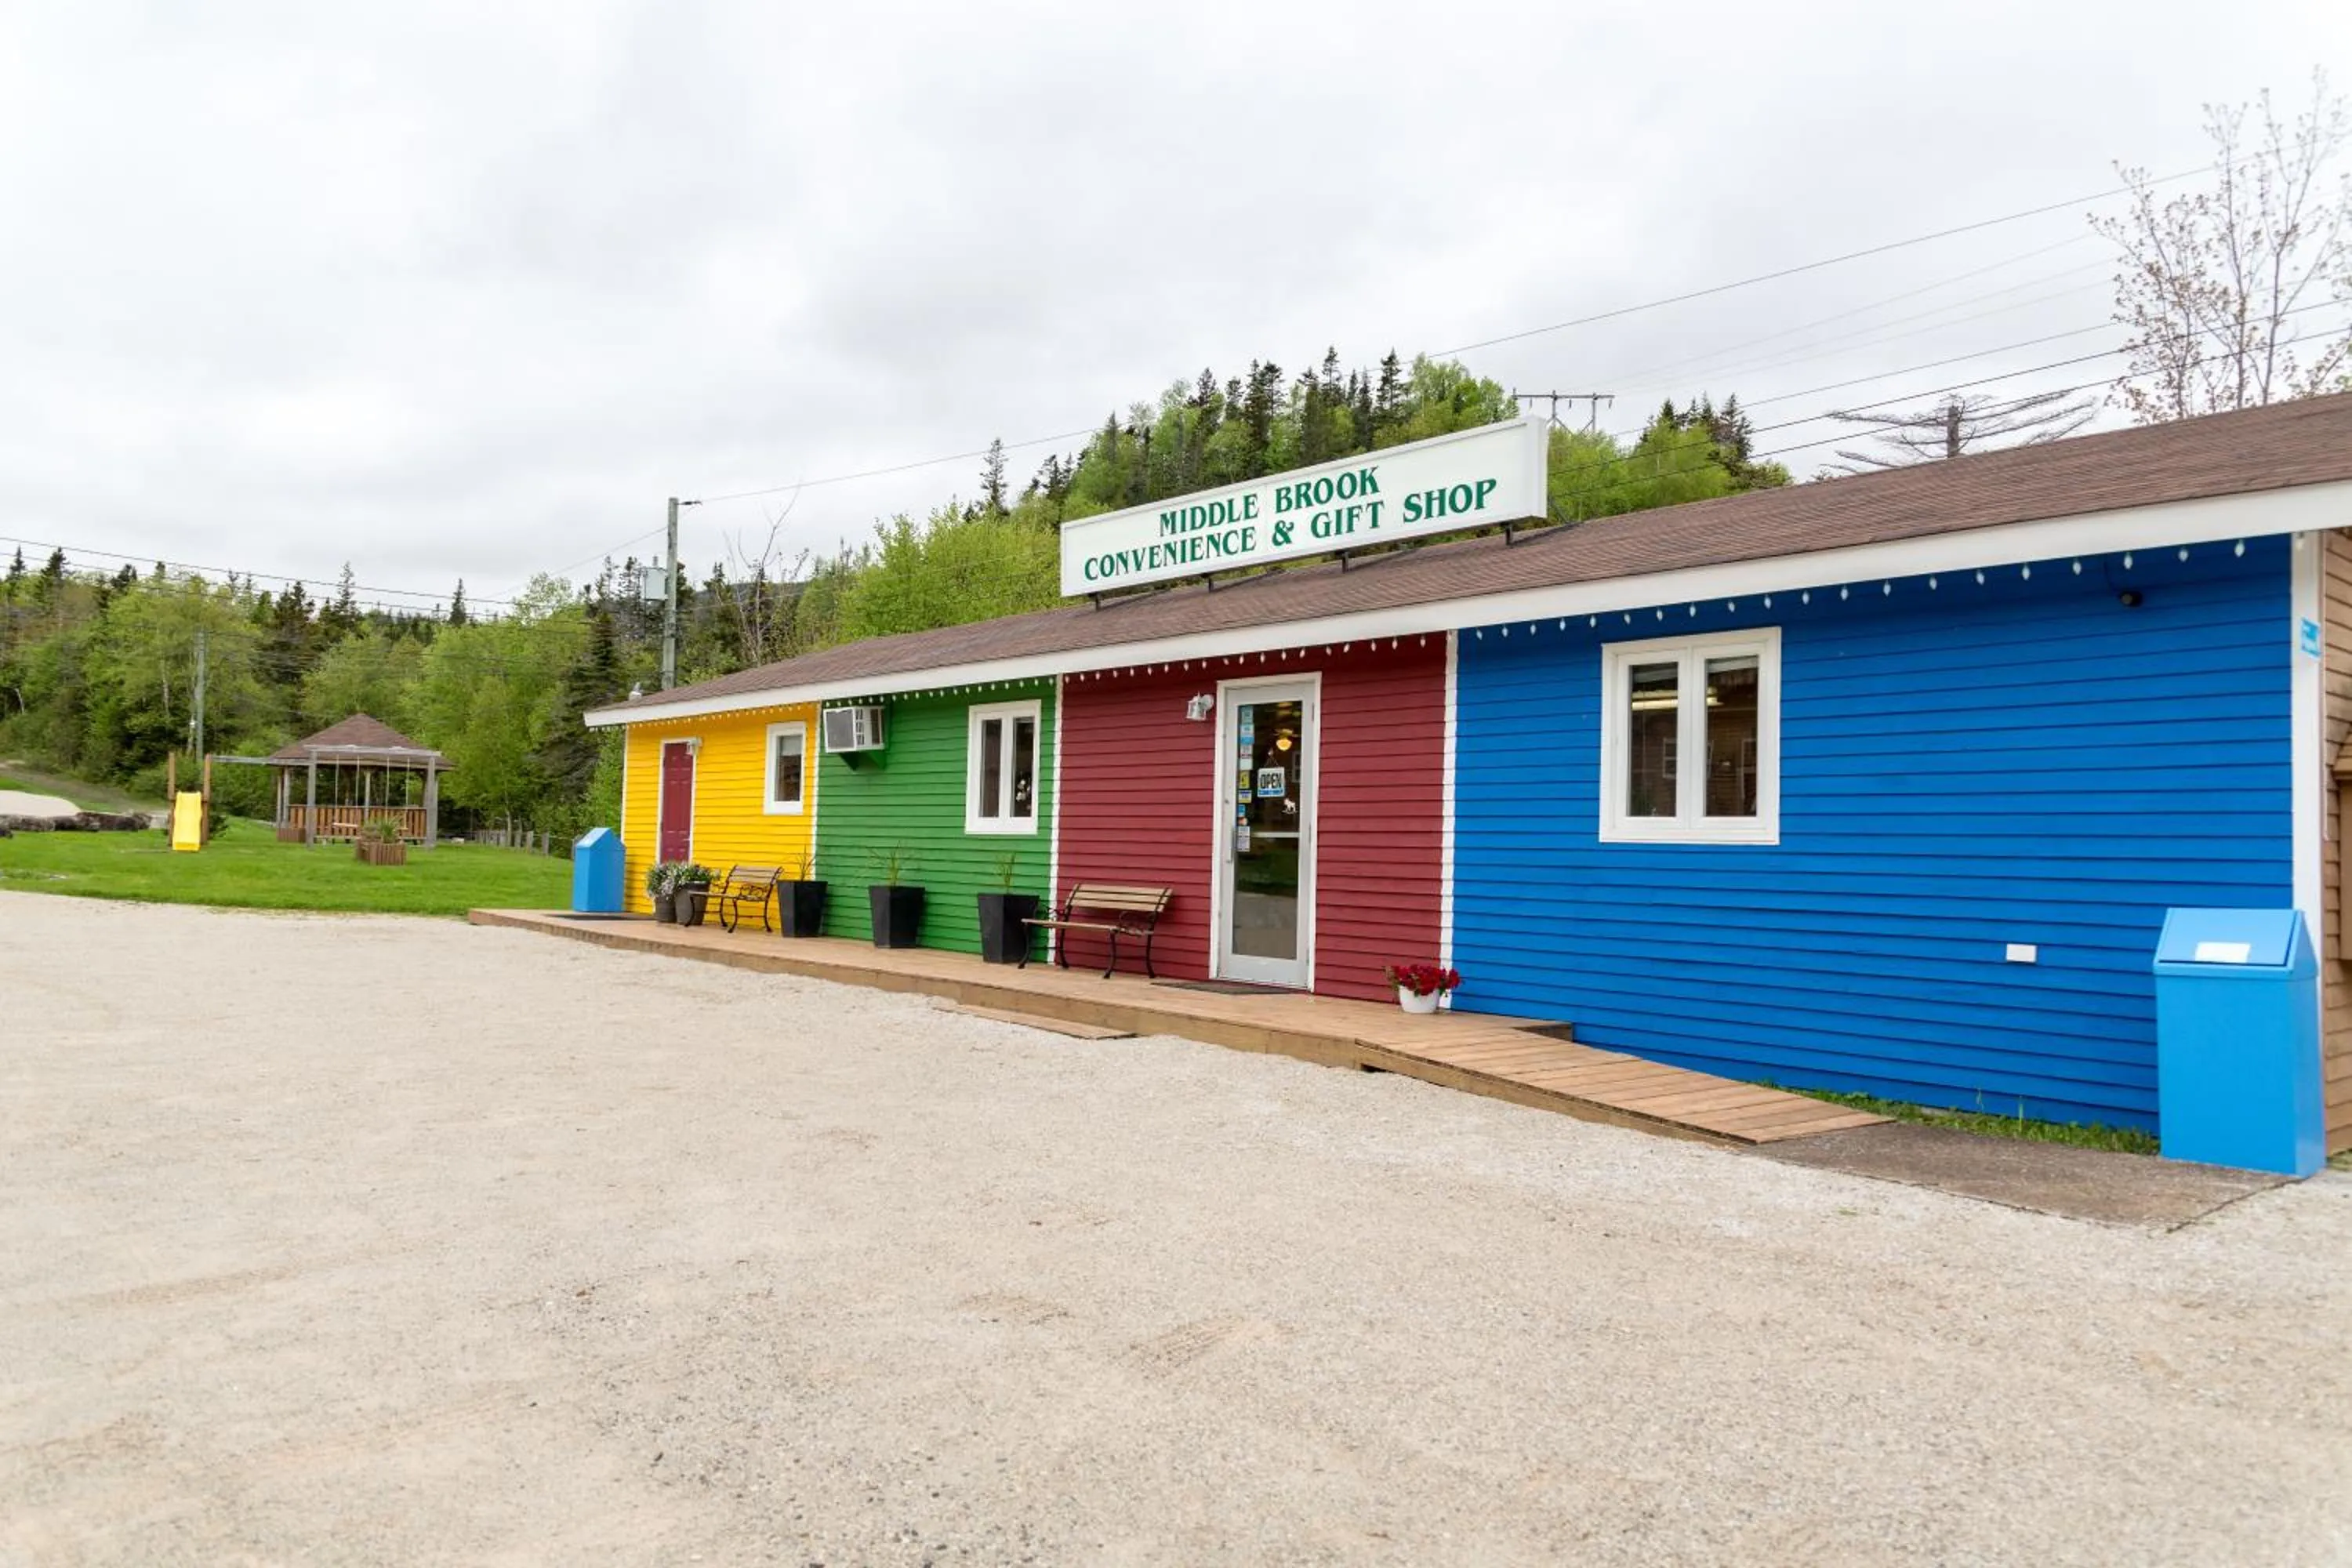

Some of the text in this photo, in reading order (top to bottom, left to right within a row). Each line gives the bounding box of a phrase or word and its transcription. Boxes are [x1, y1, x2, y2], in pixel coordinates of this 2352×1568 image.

[1084, 478, 1497, 580] CONVENIENCE & GIFT SHOP
[1160, 466, 1380, 536] MIDDLE BROOK
[1260, 772, 1283, 789] OPEN
